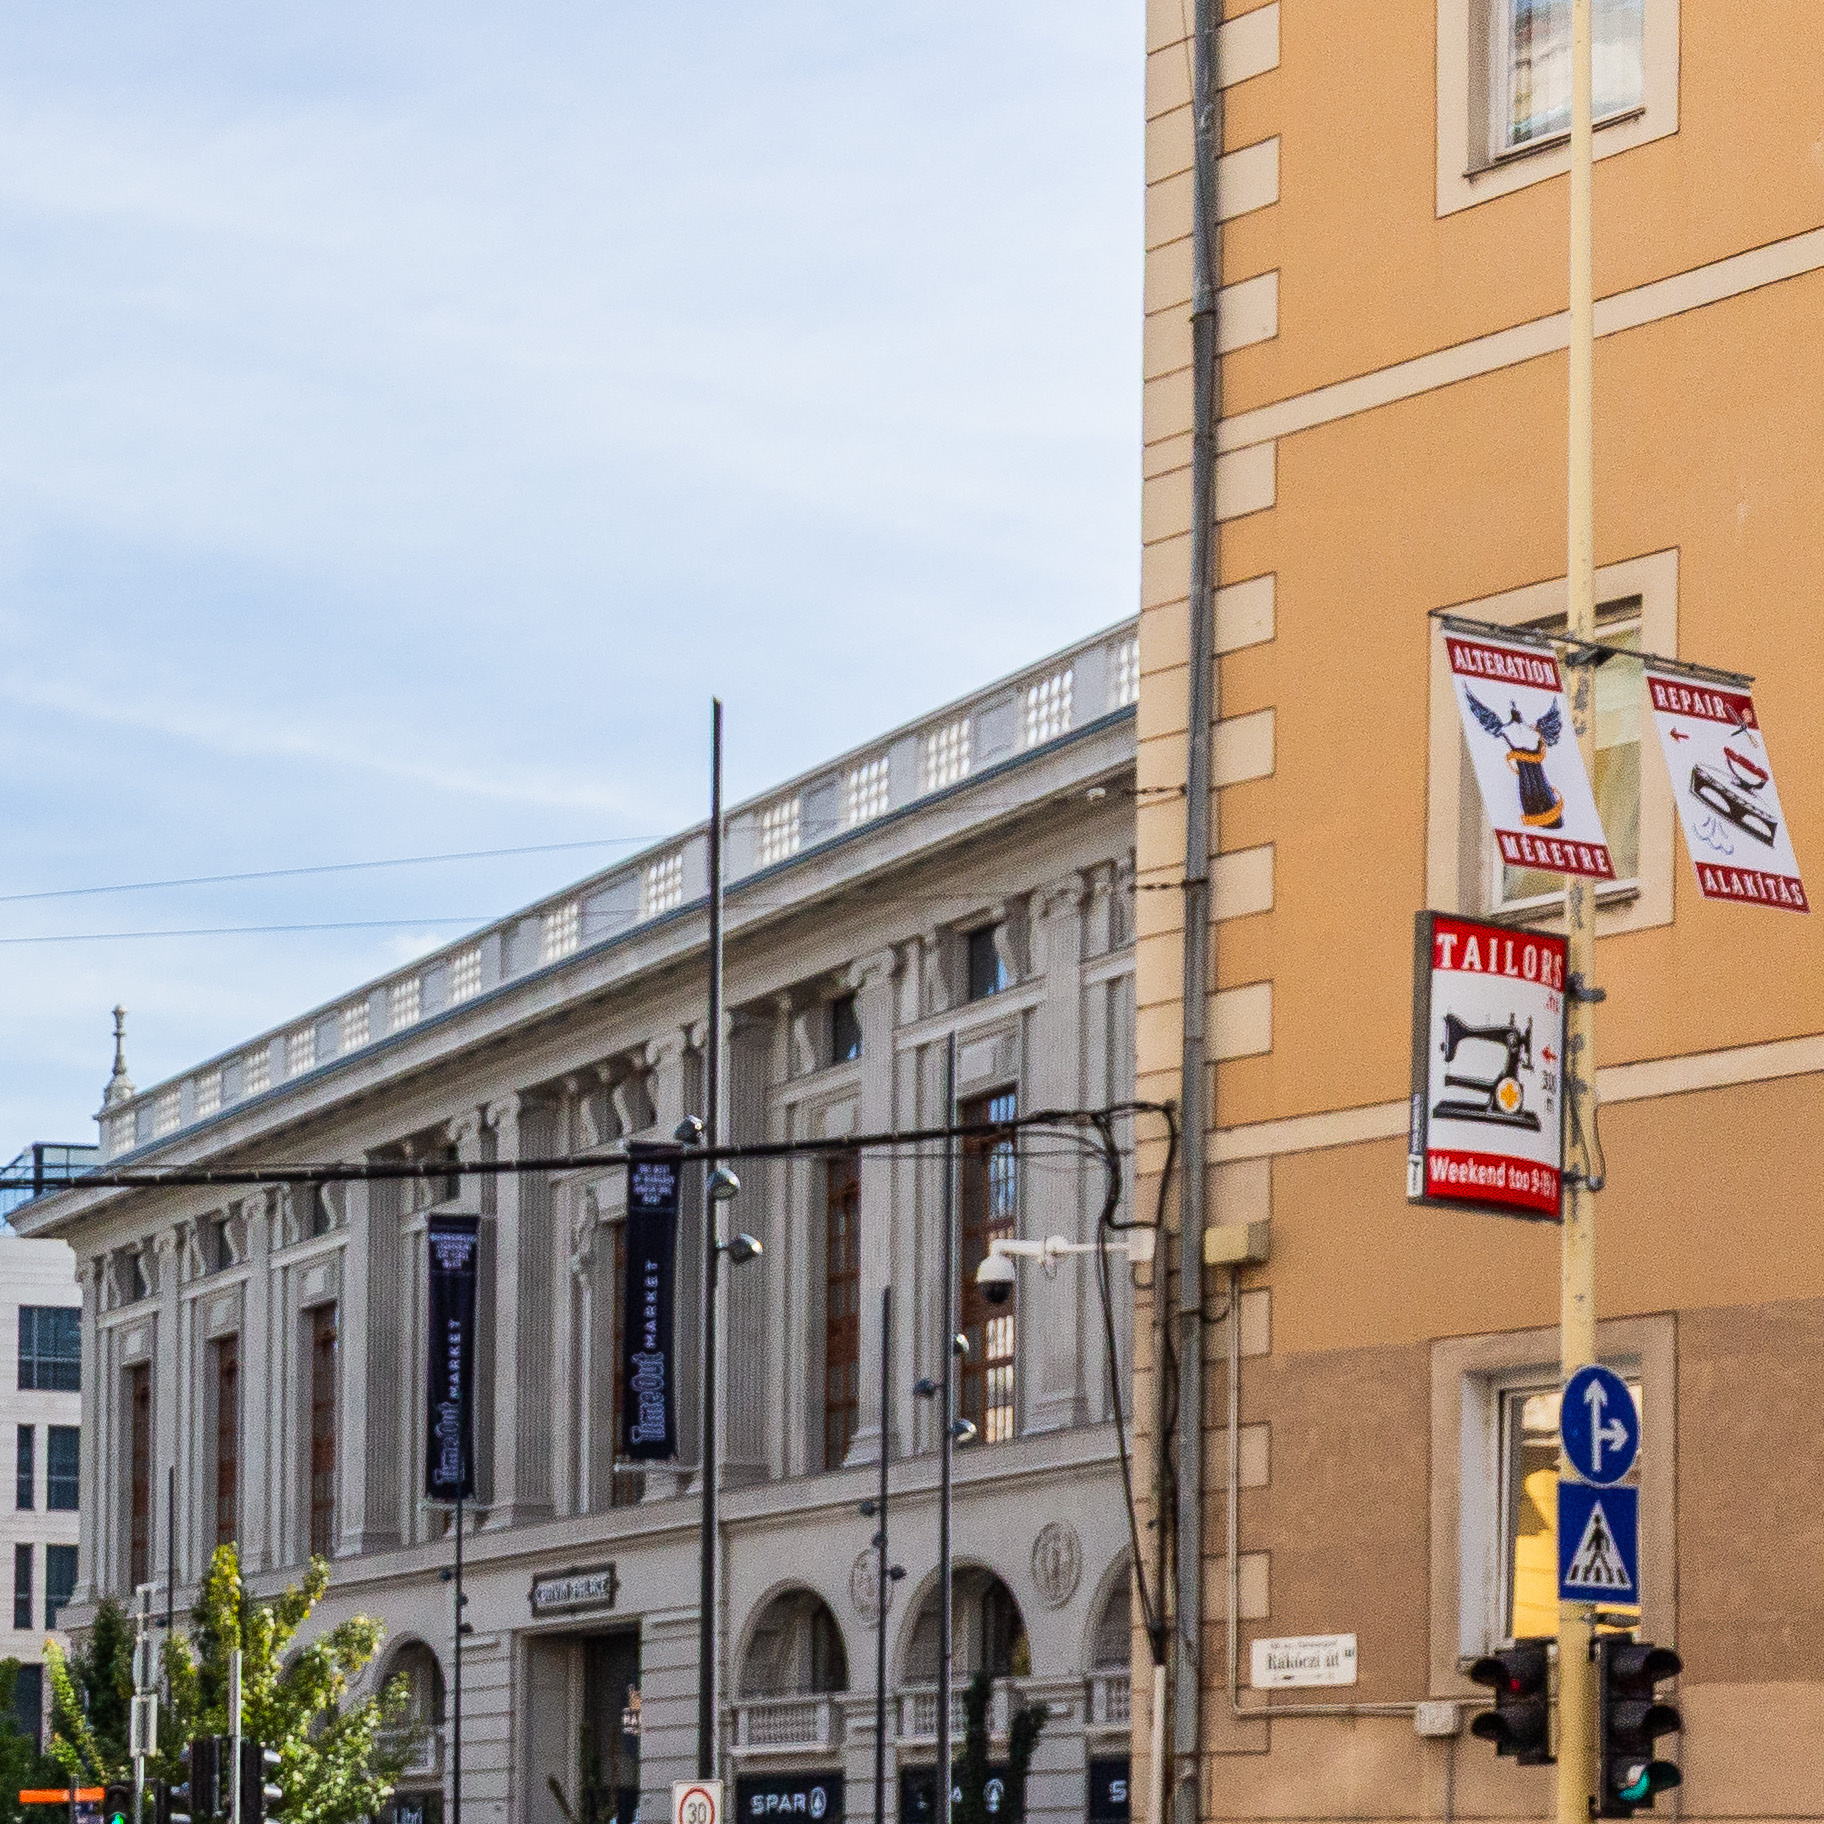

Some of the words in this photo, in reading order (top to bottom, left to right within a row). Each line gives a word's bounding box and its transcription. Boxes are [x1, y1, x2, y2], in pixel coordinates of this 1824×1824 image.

[1453, 645, 1559, 688] ALTERATION
[1653, 683, 1728, 718] REPAIR
[1502, 833, 1610, 873] MÉRETRE
[1704, 868, 1803, 906] ALAKÍTÁS
[1436, 931, 1563, 989] TAILORS
[1429, 1155, 1506, 1188] Weekend
[644, 1260, 658, 1349] MARKET
[1265, 1652, 1321, 1671] Rákóczi
[687, 1802, 707, 1824] 30
[751, 1792, 806, 1815] SPAR
